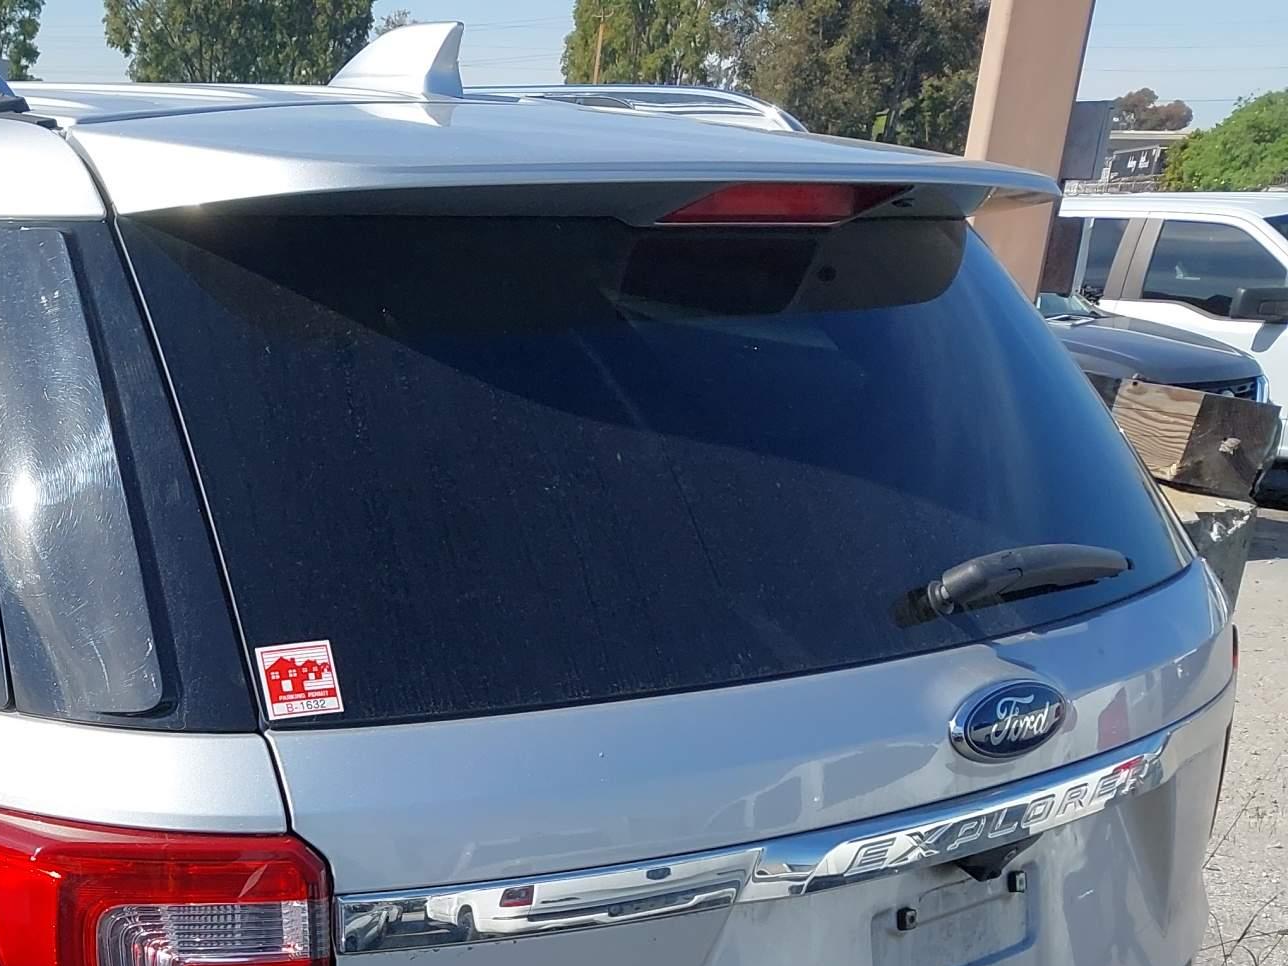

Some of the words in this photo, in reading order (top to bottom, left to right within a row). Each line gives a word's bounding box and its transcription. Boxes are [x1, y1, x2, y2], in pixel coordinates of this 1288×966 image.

[286, 699, 326, 713] B-1632
[990, 693, 1050, 746] Ford
[843, 755, 1148, 877] EXPLORER
